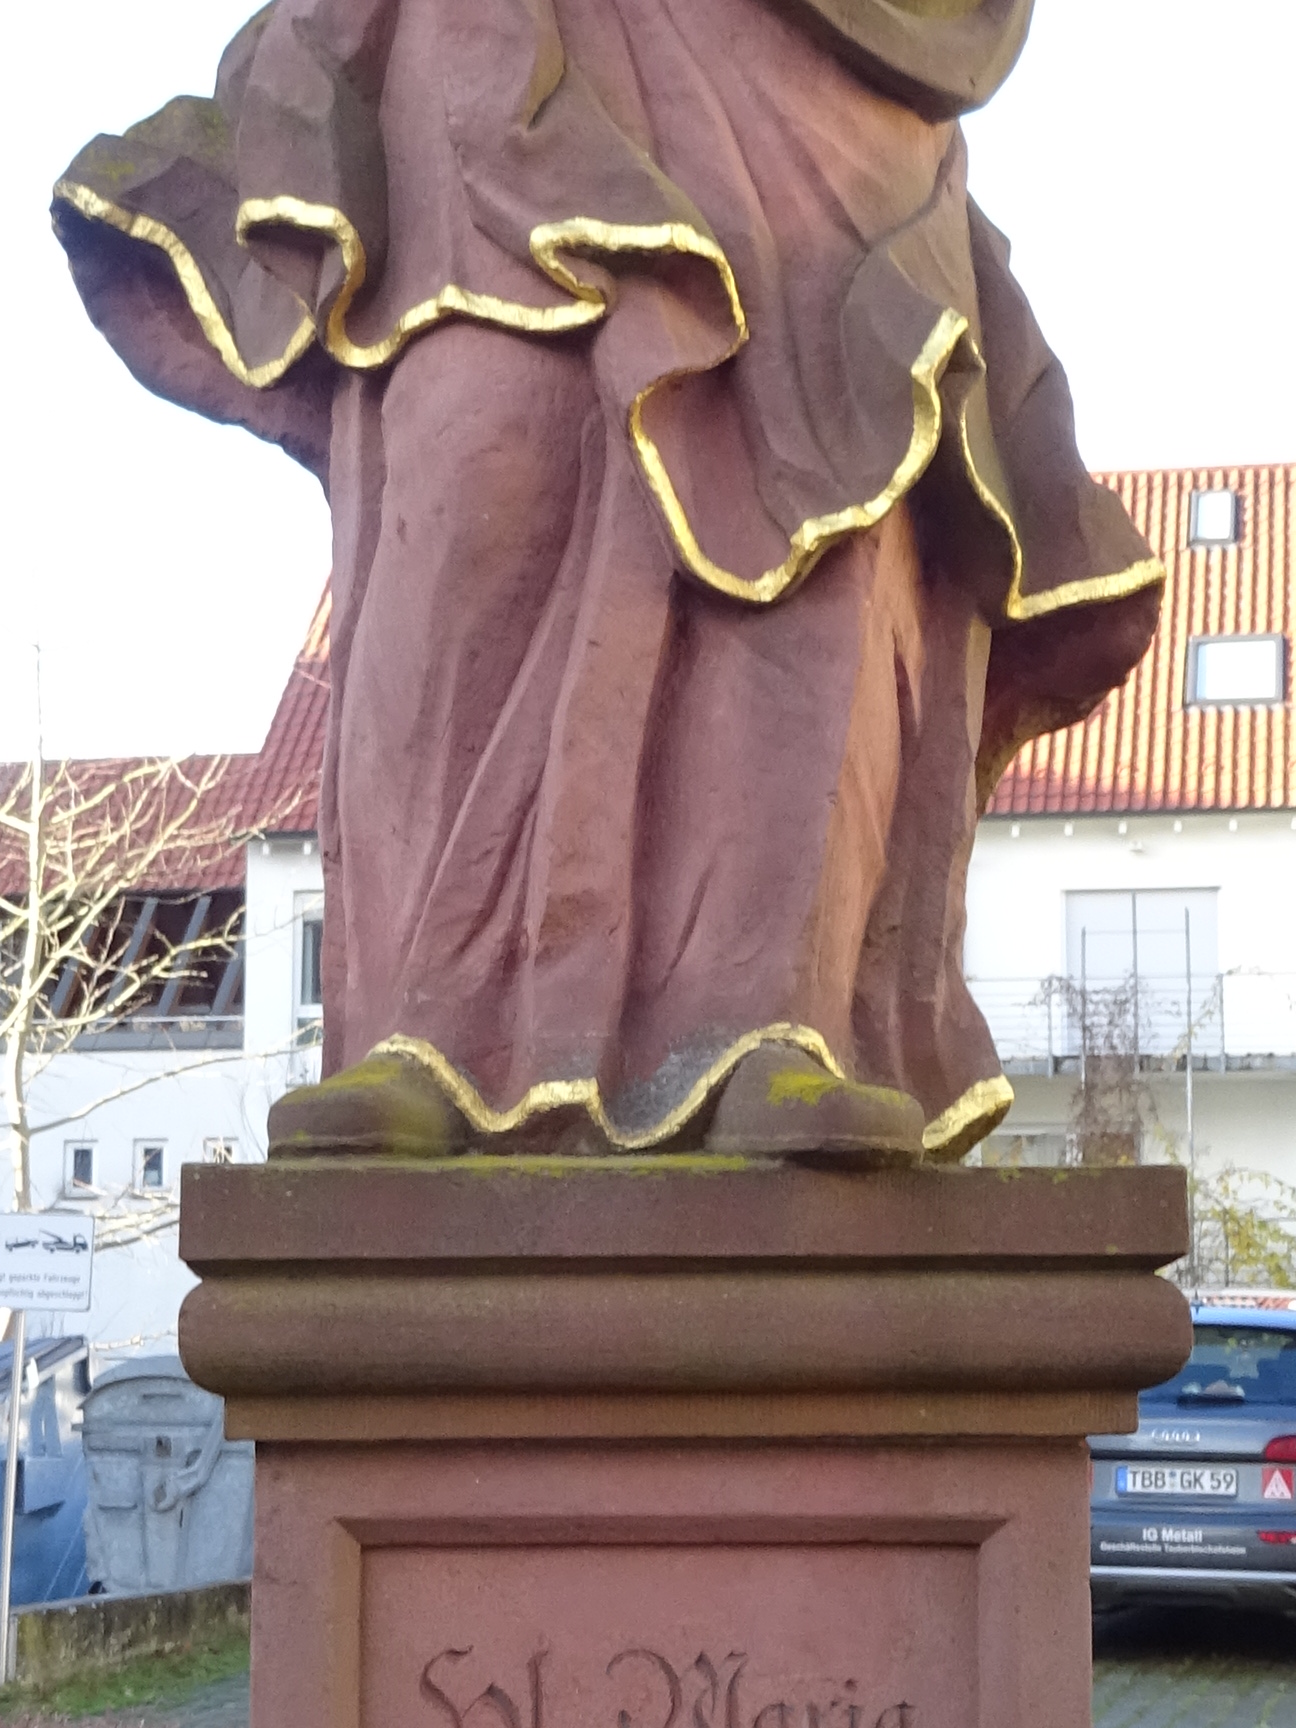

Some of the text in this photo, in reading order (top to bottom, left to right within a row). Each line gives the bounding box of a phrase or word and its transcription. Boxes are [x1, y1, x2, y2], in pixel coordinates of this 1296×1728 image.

[1130, 1470, 1235, 1491] TBB GK 59
[1142, 1527, 1203, 1543] IG Metall
